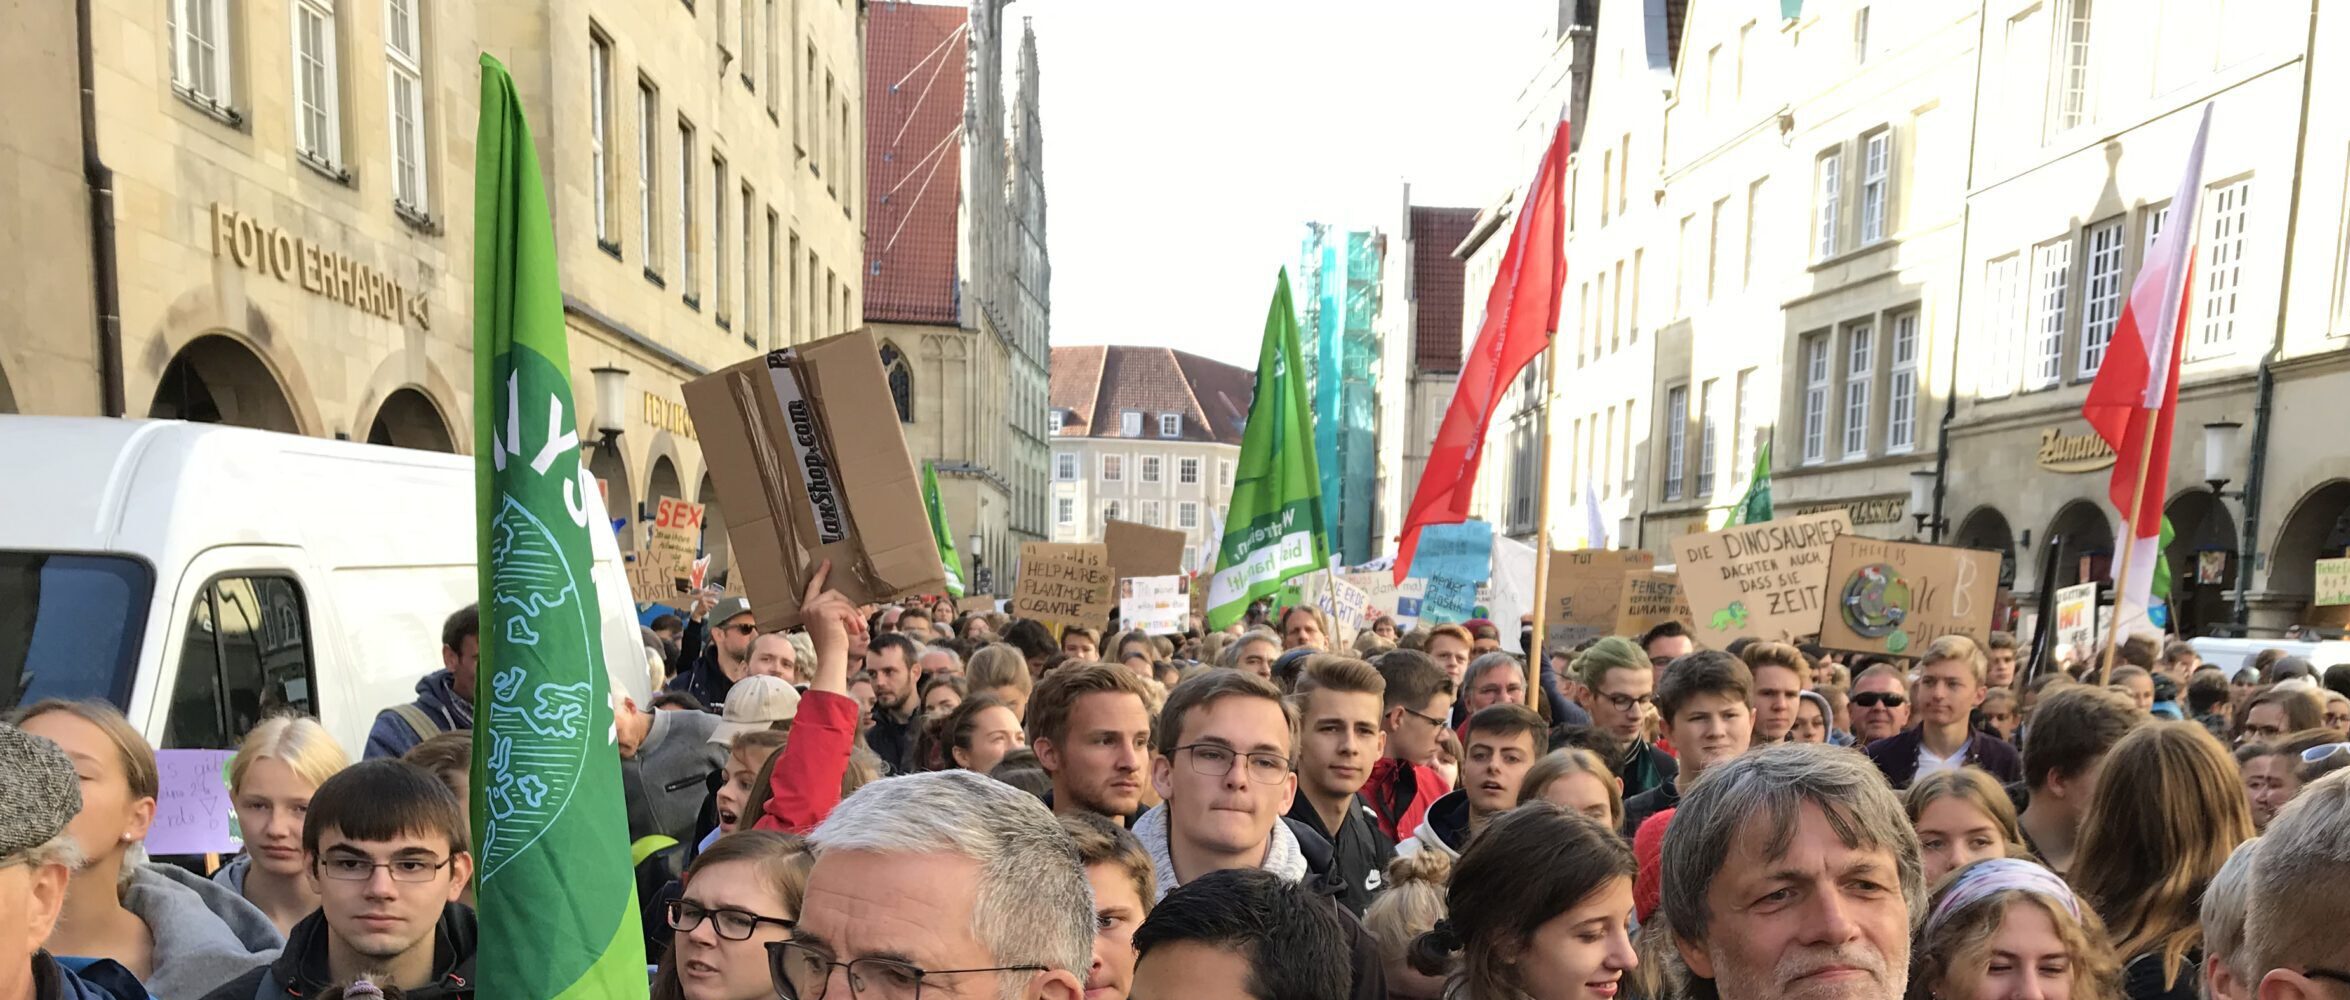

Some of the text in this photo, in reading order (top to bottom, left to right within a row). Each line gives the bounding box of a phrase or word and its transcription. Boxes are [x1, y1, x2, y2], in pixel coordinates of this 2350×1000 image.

[211, 202, 405, 325] FOTO ERHARDT
[656, 499, 703, 529] SEX
[1687, 545, 1713, 563] DIE
[1722, 519, 1843, 559] DINOSAURIER
[1028, 561, 1099, 584] HELP MRE
[1721, 559, 1779, 580] DACHTEN
[1740, 573, 1801, 594] DASS SIE
[1766, 585, 1819, 616] ZEIT
